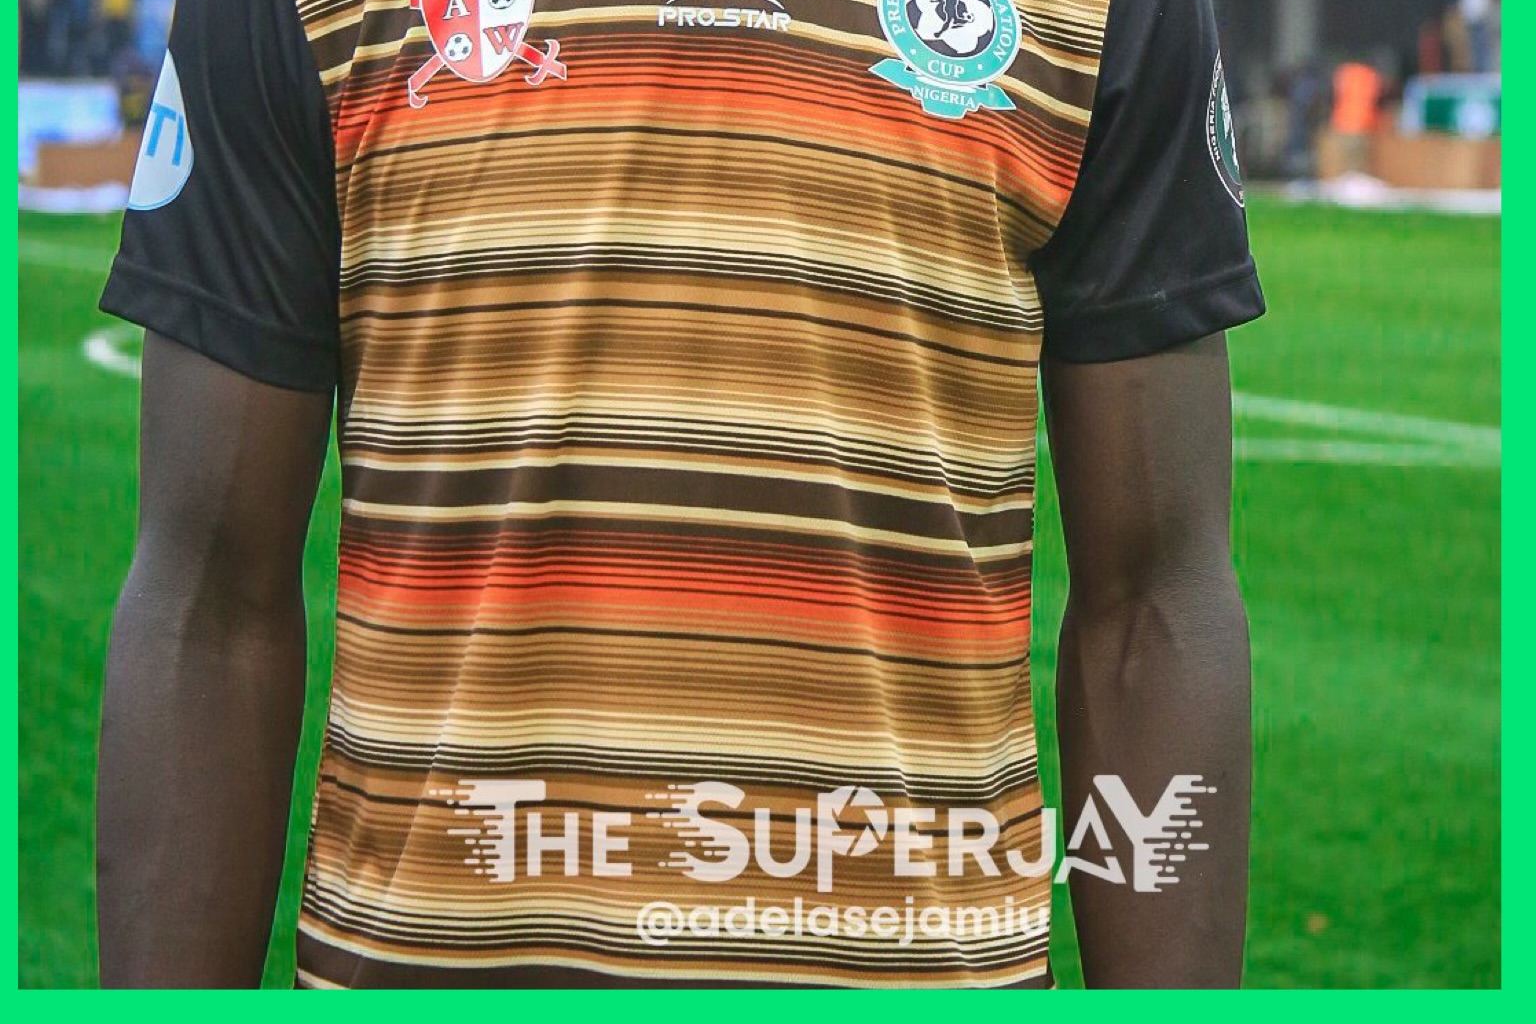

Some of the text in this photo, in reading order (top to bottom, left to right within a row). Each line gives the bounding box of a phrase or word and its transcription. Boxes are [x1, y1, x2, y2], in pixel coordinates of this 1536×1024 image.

[483, 22, 524, 56] W
[927, 59, 965, 79] CUP
[914, 86, 976, 109] NIGERIA
